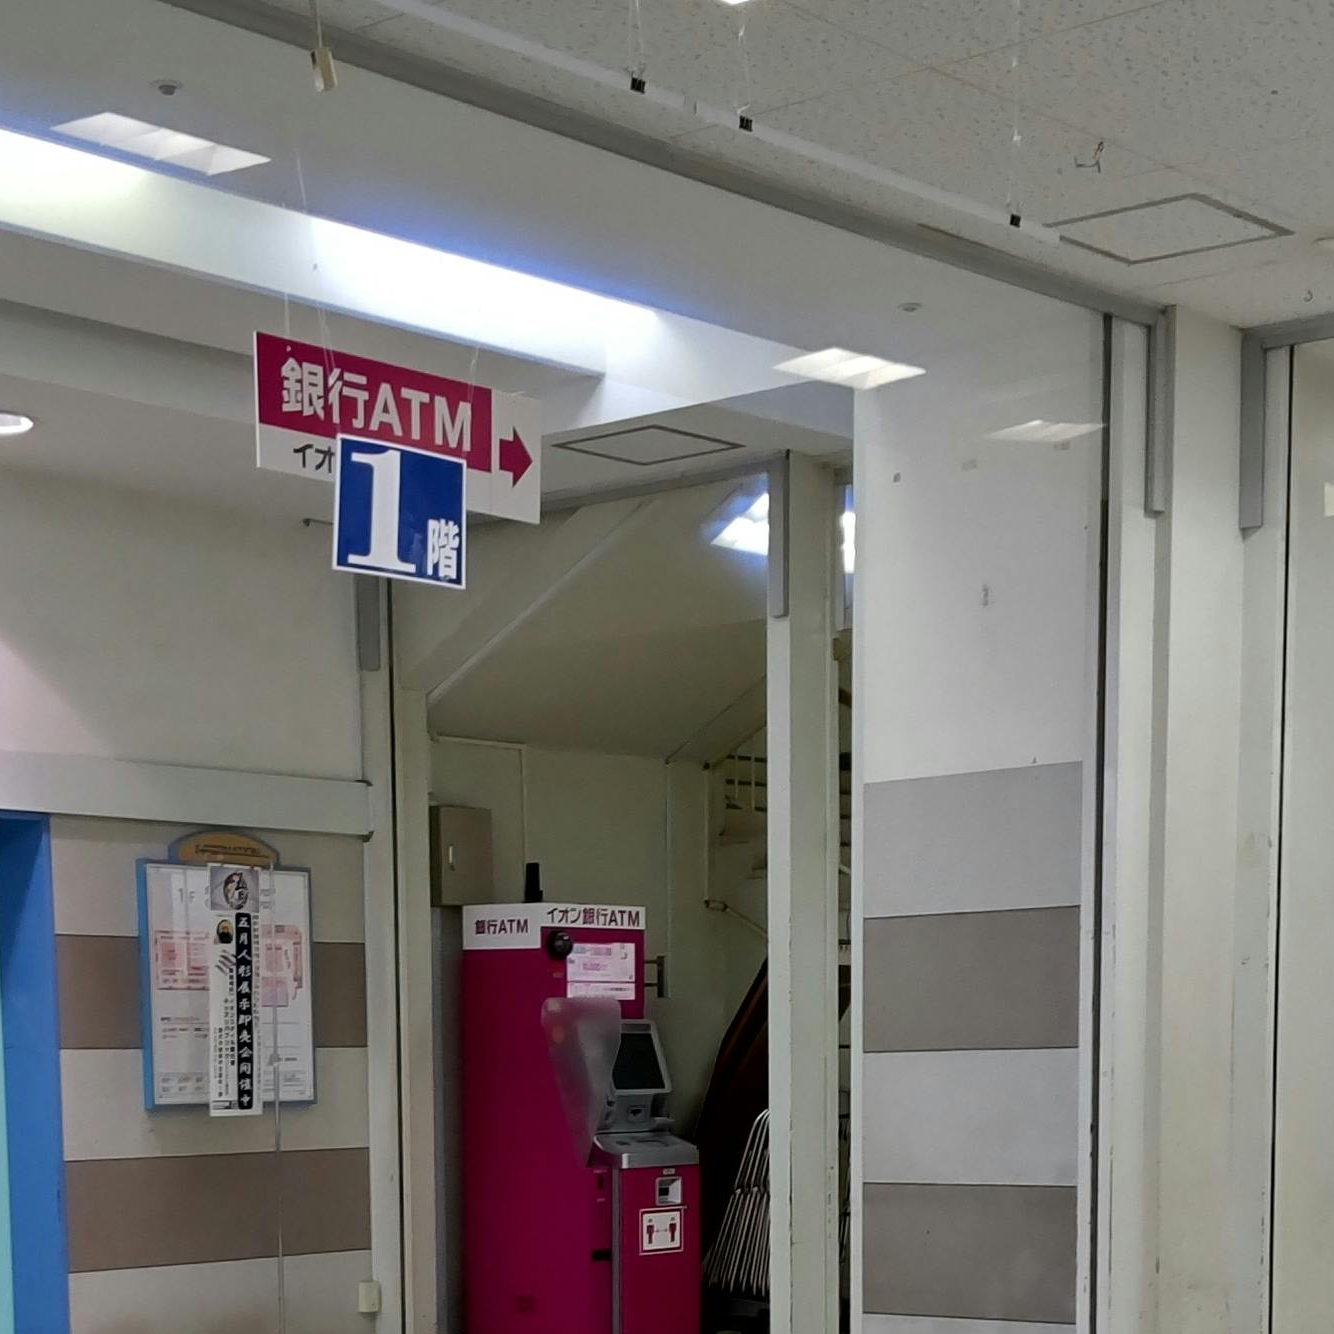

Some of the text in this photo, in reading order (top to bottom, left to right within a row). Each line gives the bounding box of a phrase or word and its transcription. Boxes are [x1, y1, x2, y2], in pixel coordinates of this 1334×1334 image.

[280, 357, 472, 452] 銀行ATM
[347, 449, 460, 580] 1階
[475, 918, 528, 935] 銀行ATM
[547, 907, 640, 927] イオン銀行ATM
